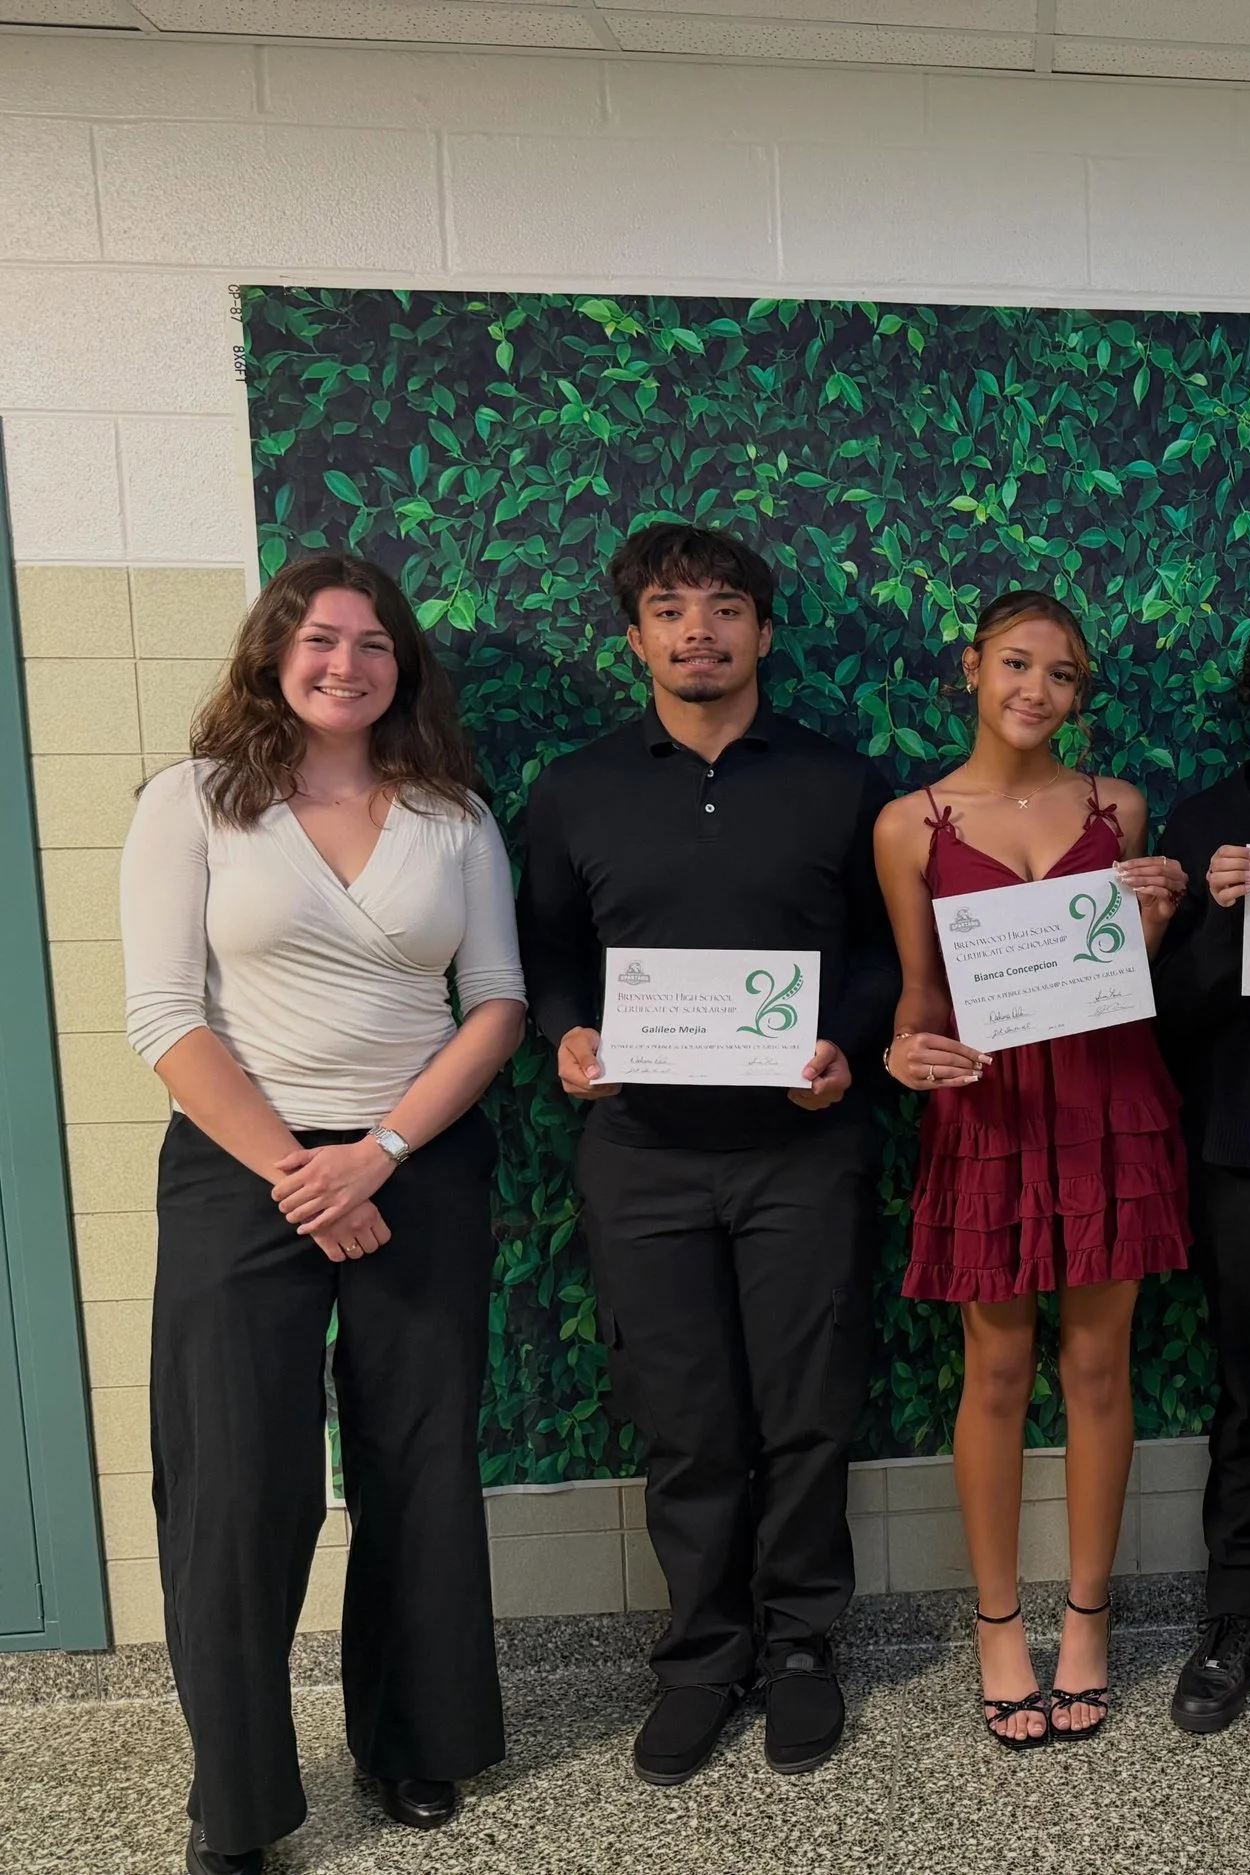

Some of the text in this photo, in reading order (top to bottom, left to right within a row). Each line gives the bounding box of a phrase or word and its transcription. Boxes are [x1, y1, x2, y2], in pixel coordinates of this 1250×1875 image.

[973, 960, 1058, 982] Bianca Concepcion
[641, 1025, 707, 1035] Galileo Mejia
